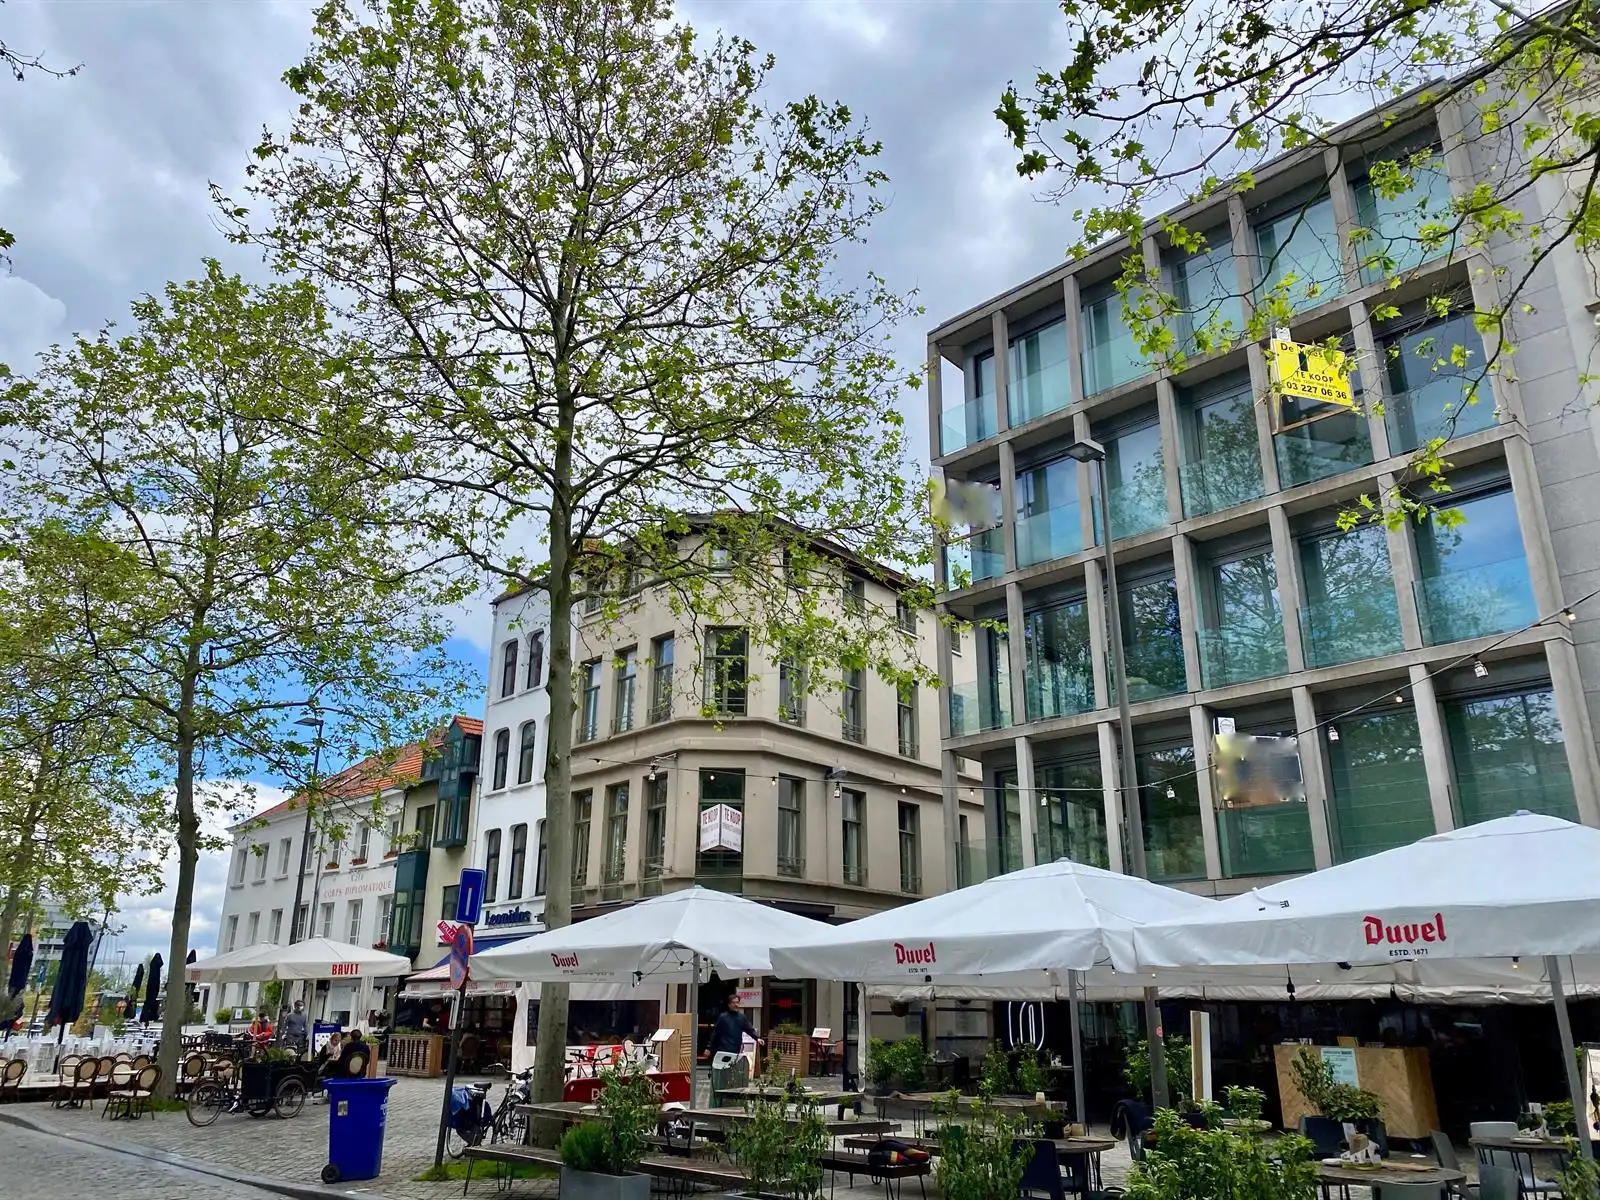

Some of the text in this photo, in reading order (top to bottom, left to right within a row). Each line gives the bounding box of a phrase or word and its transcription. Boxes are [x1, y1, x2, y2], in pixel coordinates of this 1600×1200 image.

[1280, 342, 1294, 353] De
[1295, 371, 1306, 379] TE
[1309, 372, 1334, 383] KOOP
[1286, 381, 1298, 390] 03
[1301, 384, 1318, 394] 227
[1321, 387, 1333, 397] 06
[1335, 390, 1347, 399] 36
[703, 812, 708, 825] TE
[725, 808, 730, 821] TE
[344, 880, 392, 896] DIPLOMATIQUE
[485, 905, 532, 926] Leonidas
[1363, 912, 1447, 945] Duvel
[551, 952, 579, 968] Duvel
[894, 941, 937, 965] Duvel
[1389, 949, 1411, 957] ESTD.
[331, 963, 360, 976] BAVET
